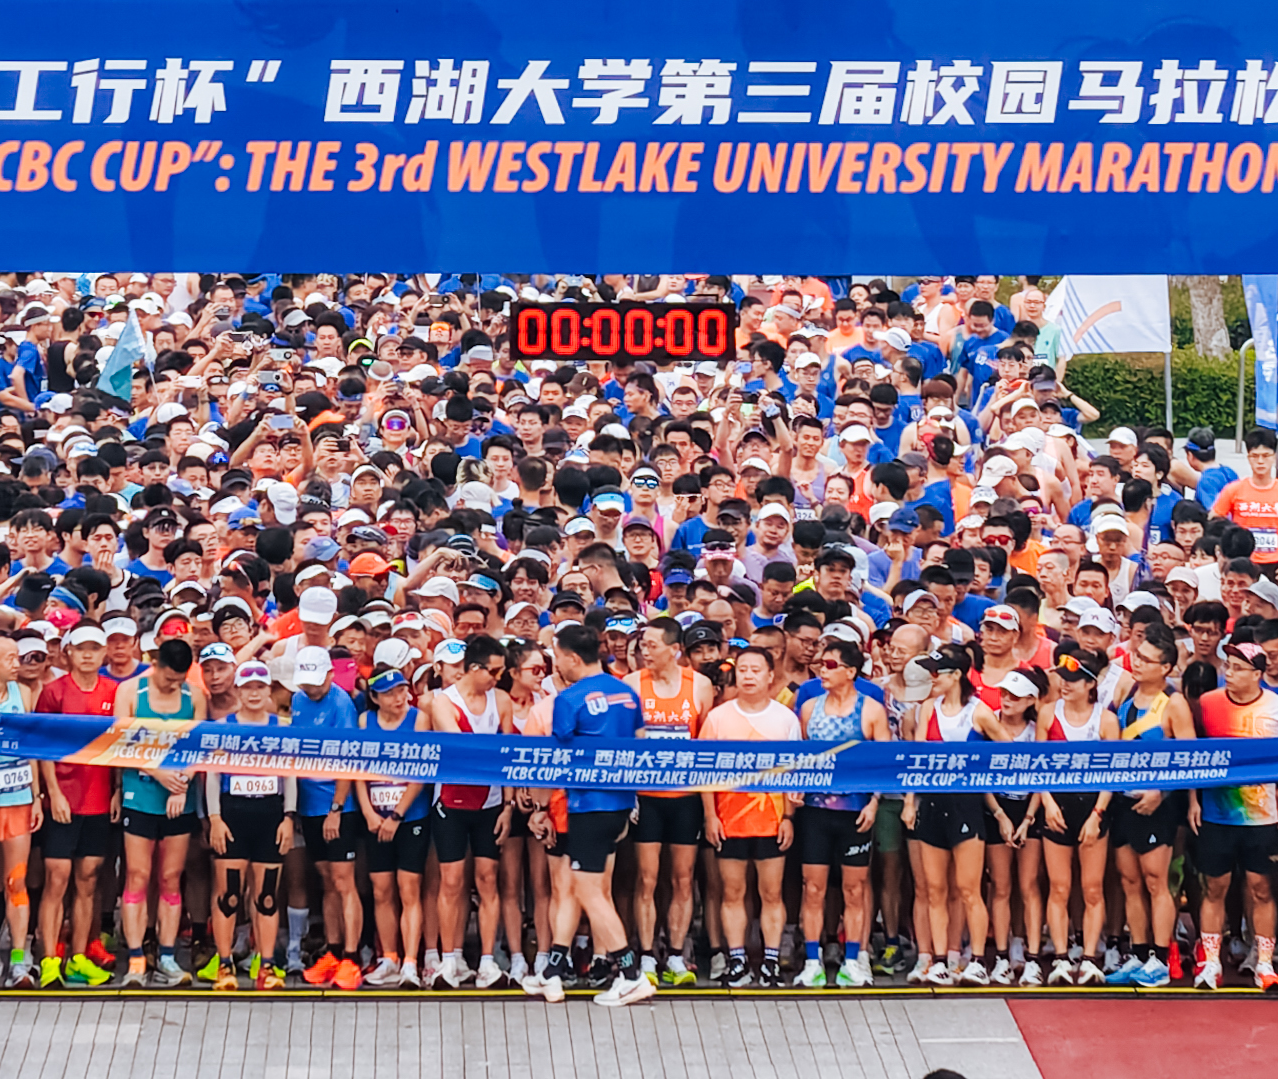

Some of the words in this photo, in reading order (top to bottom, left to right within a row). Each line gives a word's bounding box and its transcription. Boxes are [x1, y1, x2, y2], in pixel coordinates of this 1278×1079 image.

[245, 140, 342, 193] THE
[347, 140, 439, 193] 3rd
[447, 140, 706, 193] WESTLAKE
[712, 140, 1016, 194] UNIVERSITY
[518, 308, 727, 356] 00:00:00
[200, 732, 441, 762] 西湖大学第三届校园马拉松
[180, 750, 203, 764] THE
[206, 751, 227, 766] 3rd
[229, 752, 293, 771] WESTLAKE
[294, 757, 368, 774] UNIVERSITY
[367, 760, 439, 777] MARATHON
[594, 749, 837, 771] 西湖大学第三届校园马拉松
[989, 749, 1232, 770] 西湖大学第三届校园马拉松
[3, 770, 29, 785] 0769
[233, 781, 242, 792] A
[246, 779, 274, 792] 0963
[574, 768, 597, 783] THE
[599, 768, 621, 784] 3rd
[622, 769, 687, 786] WESTLAKE
[688, 771, 763, 787] UNIVERSITY
[762, 771, 833, 787] MARATHON
[969, 772, 992, 787] THE
[994, 772, 1017, 787] 3rd
[1018, 771, 1081, 786] WESTLAKE
[1083, 770, 1158, 785] UNIVERSITY
[1157, 768, 1228, 782] MARATHON
